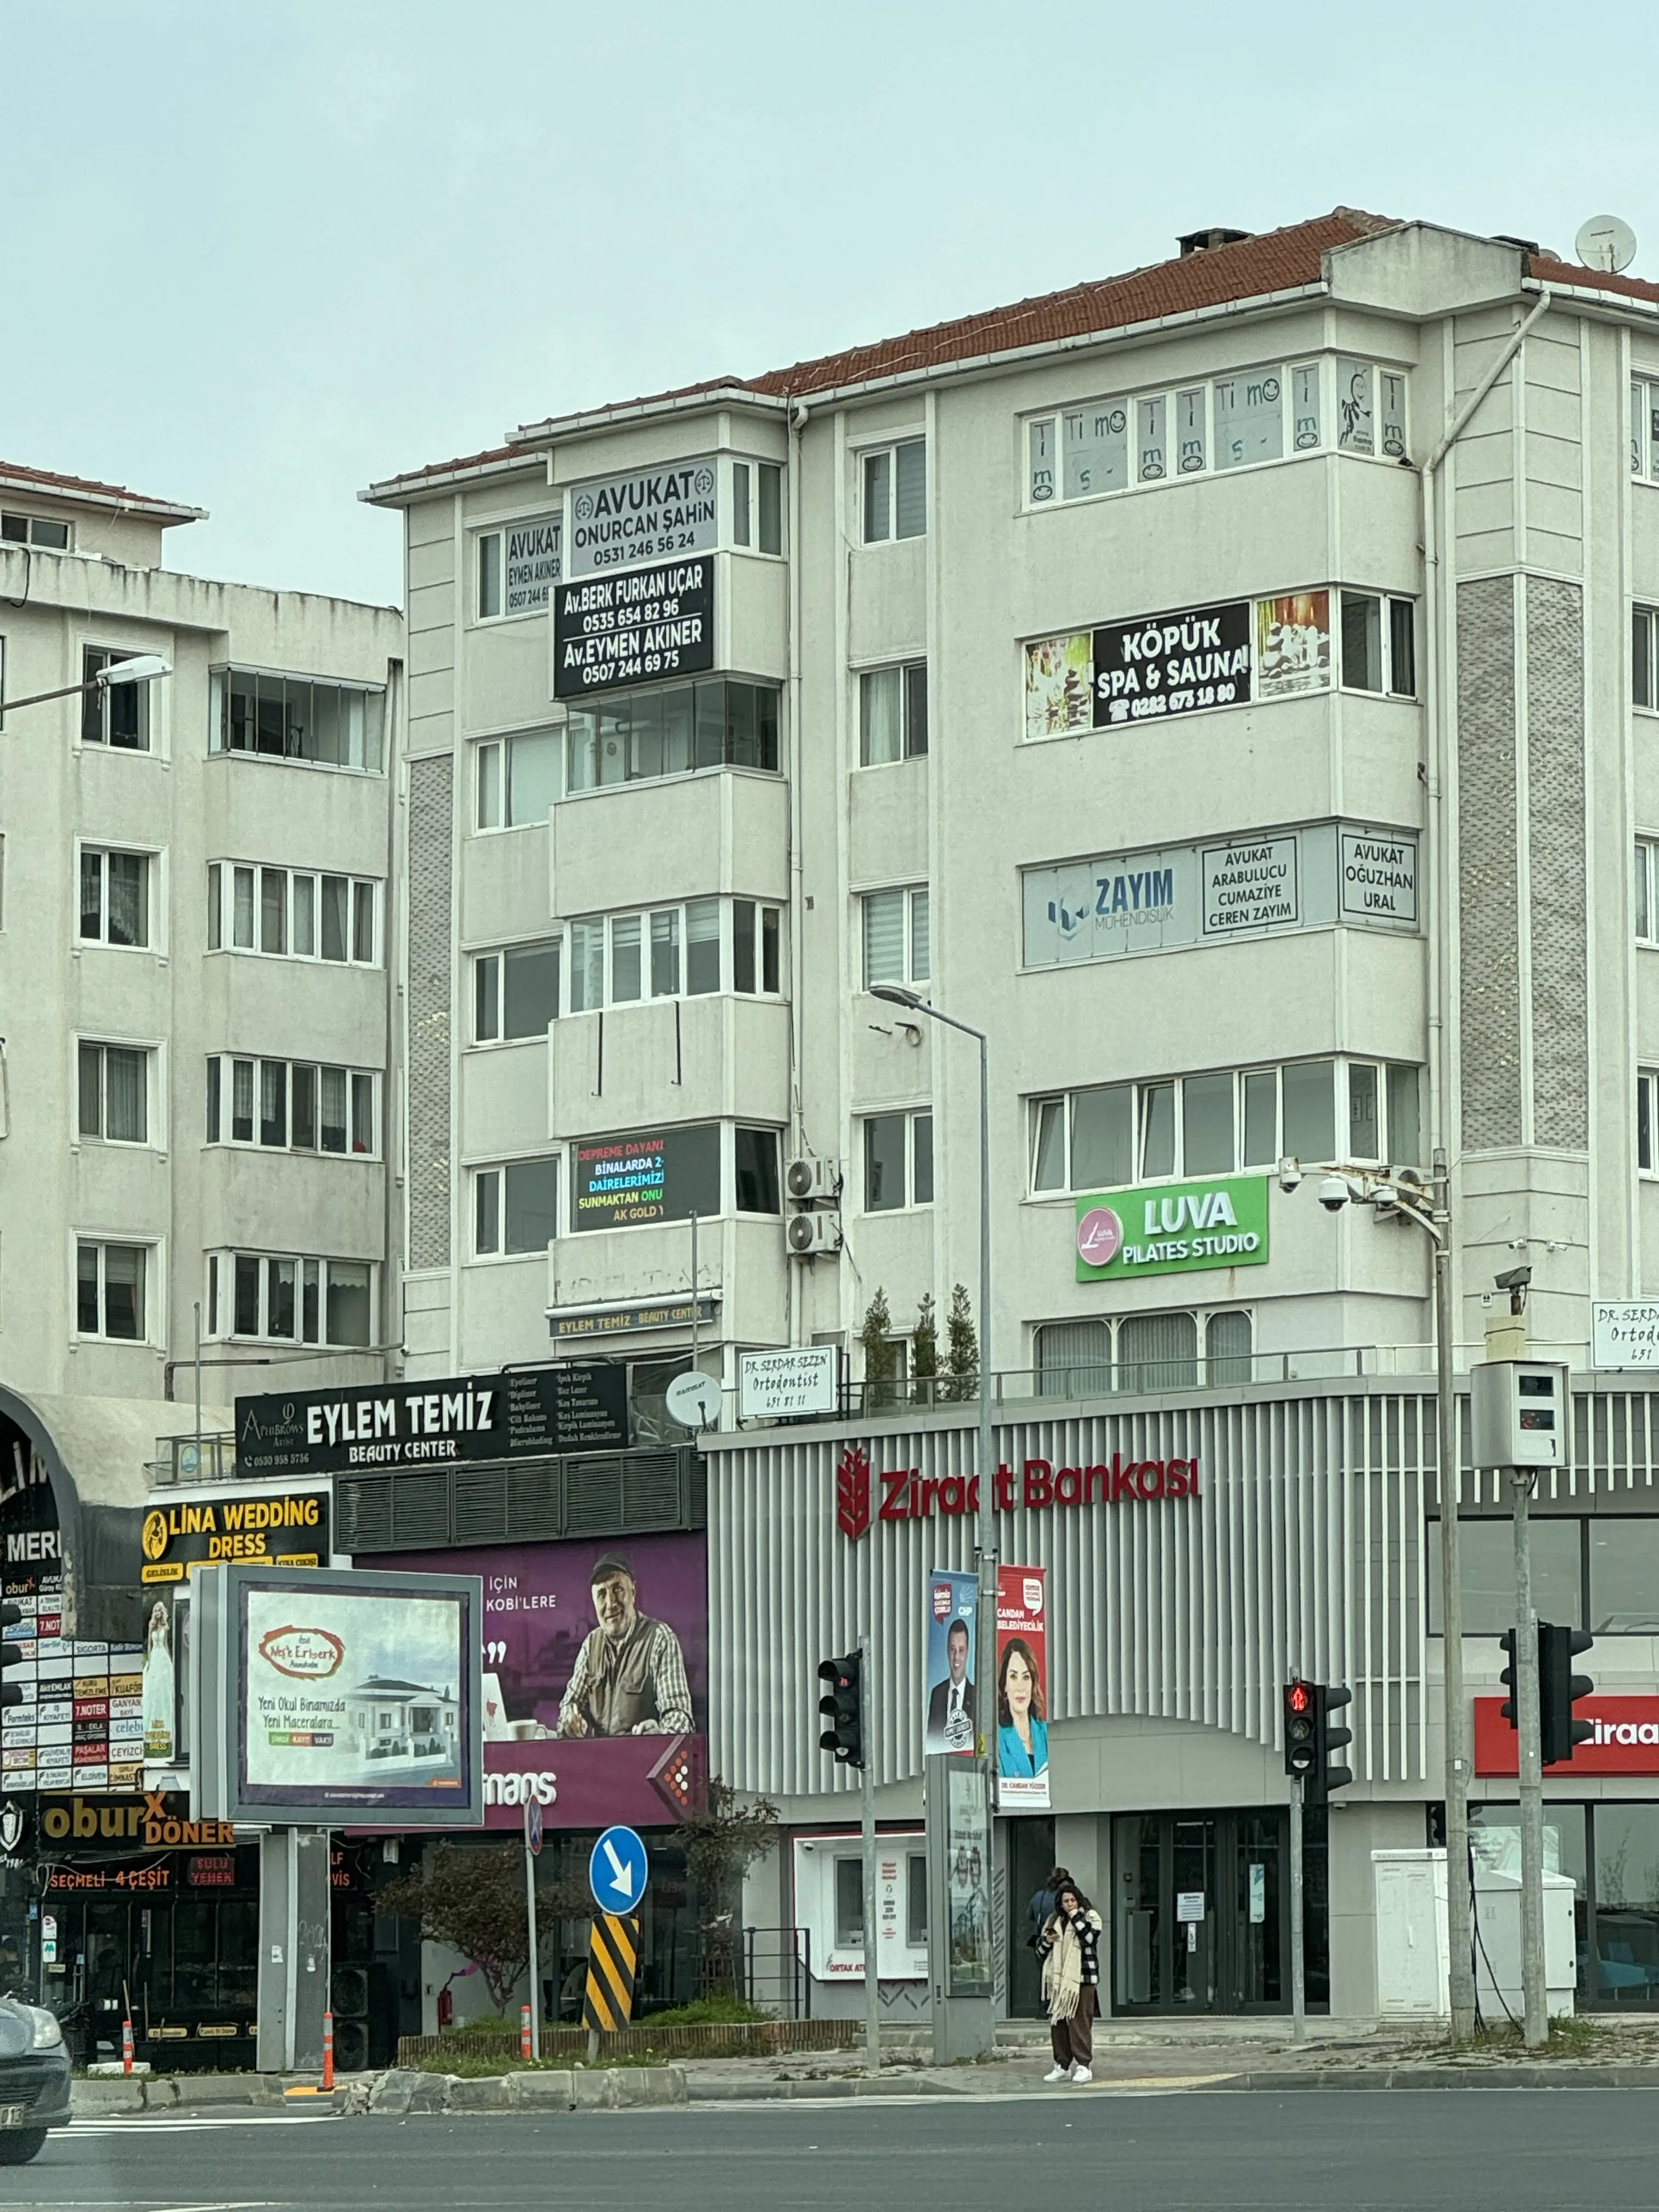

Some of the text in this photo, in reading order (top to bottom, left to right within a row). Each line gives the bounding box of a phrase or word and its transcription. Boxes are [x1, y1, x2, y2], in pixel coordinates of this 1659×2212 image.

[594, 470, 695, 518] AVUKAT
[575, 512, 657, 548] ONURCAN
[509, 526, 560, 561] AVUKAT
[594, 532, 695, 566] 0531 246 56 24
[509, 558, 561, 587] EYMEN AKINER
[509, 591, 526, 608] 0507
[528, 589, 540, 604] 244
[564, 565, 702, 615] Av.BERK FURKAN UÇAR
[583, 599, 678, 633] 0535 654 82 96
[564, 619, 702, 668] Av.EYMEN AKINER
[1122, 616, 1222, 662] KÖPÜK
[583, 651, 679, 684] 0507 244 69 75
[1098, 648, 1247, 699] SPA & SAUNA
[1131, 693, 1167, 719] 0282
[1169, 689, 1194, 710] 673
[1217, 684, 1235, 702] 80
[1224, 847, 1273, 866] AVUKAT
[1354, 844, 1404, 865] AVUKAT
[1212, 864, 1286, 888] ARABULUCU
[1346, 863, 1413, 890] OĞUZHAN
[1096, 868, 1173, 914] ZAYIM
[1218, 884, 1282, 906] CUMAZİYE
[1363, 891, 1396, 911] URAL
[1209, 902, 1291, 927] CEREN ZAYIM
[579, 1145, 623, 1161] DEPREME
[595, 1157, 652, 1176] BİNALARDA
[579, 1192, 639, 1209] SUNMAKTAN
[614, 1209, 628, 1221] AK
[630, 1206, 656, 1219] GOLD
[1144, 1192, 1237, 1235] LUVA
[1122, 1232, 1260, 1264] PILATES STUDIO
[559, 1321, 594, 1333] EYLEM
[597, 1313, 630, 1329] TEMİZ
[639, 1310, 669, 1323] BEAUTY
[1622, 1308, 1659, 1323] SERD
[1611, 1325, 1659, 1346] Ortod
[1632, 1349, 1652, 1360] 651
[753, 1373, 819, 1393] Ortodontist
[307, 1381, 494, 1447] EYLEM TEMİZ
[349, 1440, 456, 1463] BEAUTY CENTER
[1023, 1452, 1203, 1509] Bankası
[170, 1497, 319, 1535] LİNA WEDDİNG
[209, 1533, 266, 1559] DRESS
[6, 1582, 29, 1595] obur
[486, 1595, 556, 1612] KOBİ'LERE
[258, 1696, 275, 1710] Yeni
[279, 1696, 297, 1711] Okul
[263, 1714, 280, 1728] Yeni
[44, 1797, 145, 1838] obur
[145, 1816, 235, 1844] DÖNER
[331, 1852, 343, 1865] LF
[50, 1870, 105, 1891] SEÇMELİ
[129, 1866, 170, 1890] ÇEŞİT
